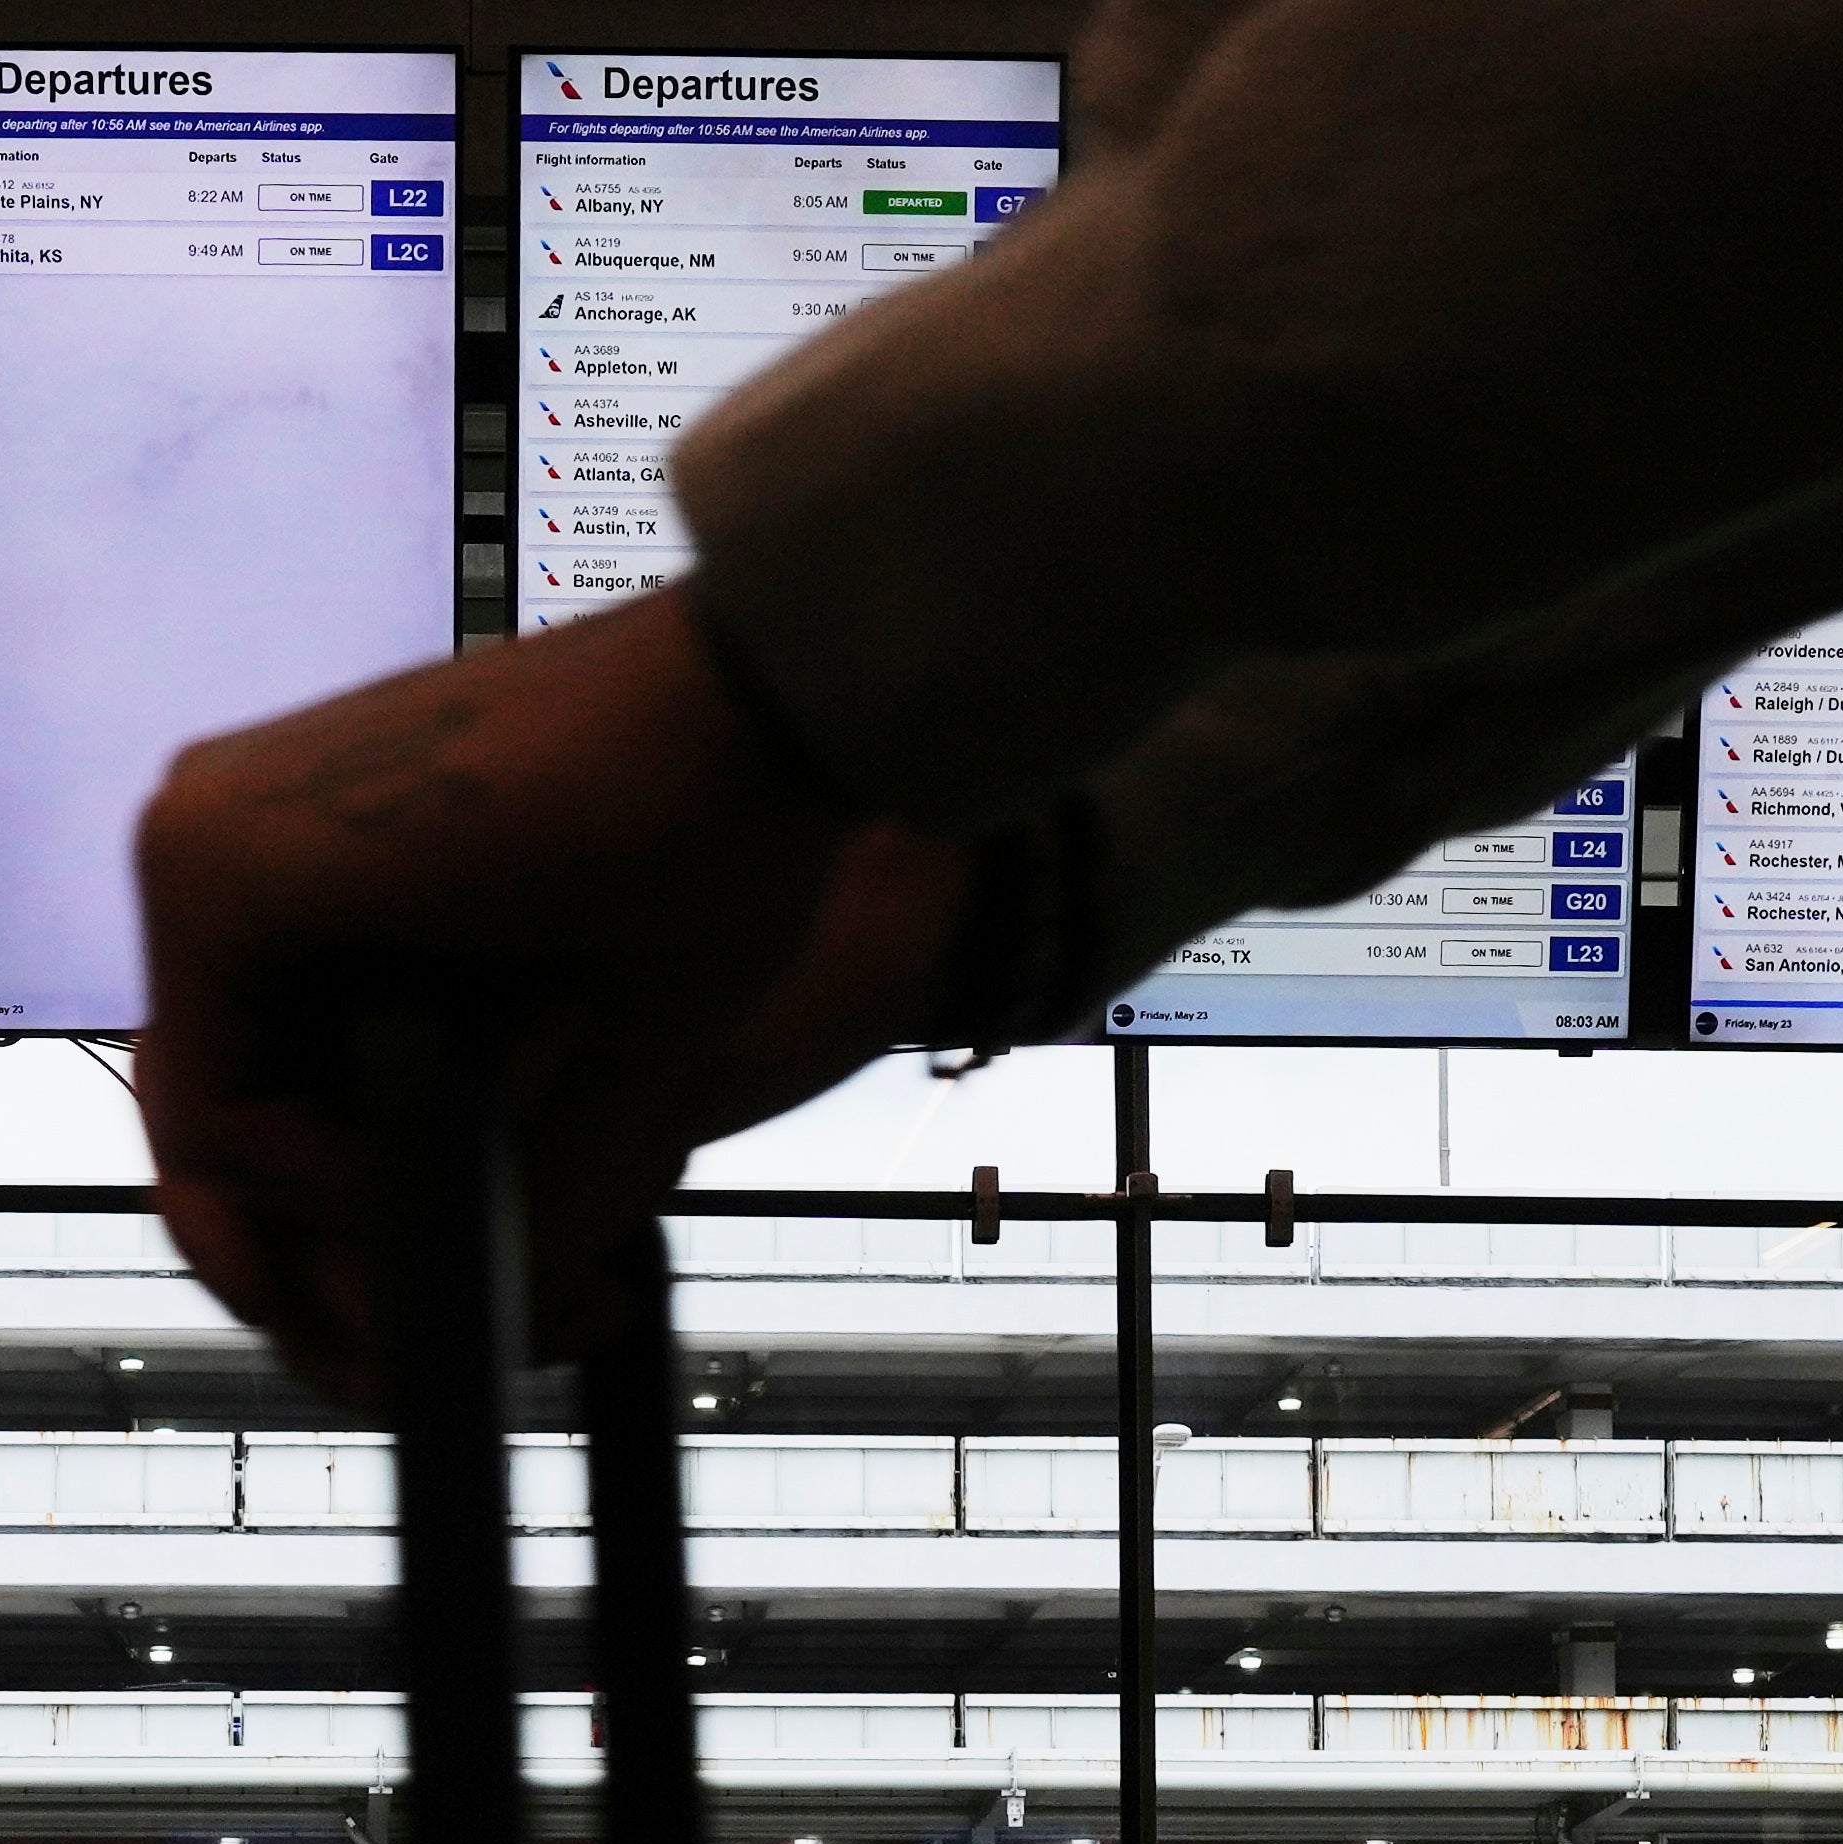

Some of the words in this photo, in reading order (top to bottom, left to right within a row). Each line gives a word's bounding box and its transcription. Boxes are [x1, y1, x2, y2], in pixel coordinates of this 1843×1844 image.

[605, 67, 818, 108] Departures
[21, 195, 74, 211] Plains,
[81, 196, 103, 208] NY
[390, 189, 427, 207] L22
[576, 199, 634, 216] Albany,
[641, 200, 663, 213] NY
[40, 249, 62, 263] KS
[388, 243, 428, 261] L2C
[575, 253, 683, 270] Albuquerque,
[690, 254, 714, 267] NM
[575, 307, 667, 324] Anchorage,
[672, 308, 696, 321] AK
[575, 361, 651, 377] Appleton,
[657, 361, 676, 374] WI
[574, 521, 629, 536] Austin,
[636, 522, 656, 534] TX
[1577, 789, 1603, 805] K6
[1752, 802, 1834, 817] Richmond,
[1570, 841, 1606, 858] L24
[1750, 854, 1831, 869] Rochester,
[1567, 893, 1606, 910] G20
[1748, 906, 1829, 922] Rochester,
[1568, 945, 1603, 962] L23
[1746, 958, 1774, 971] San
[1779, 959, 1843, 974] Antonio,
[13, 1005, 23, 1013] 23
